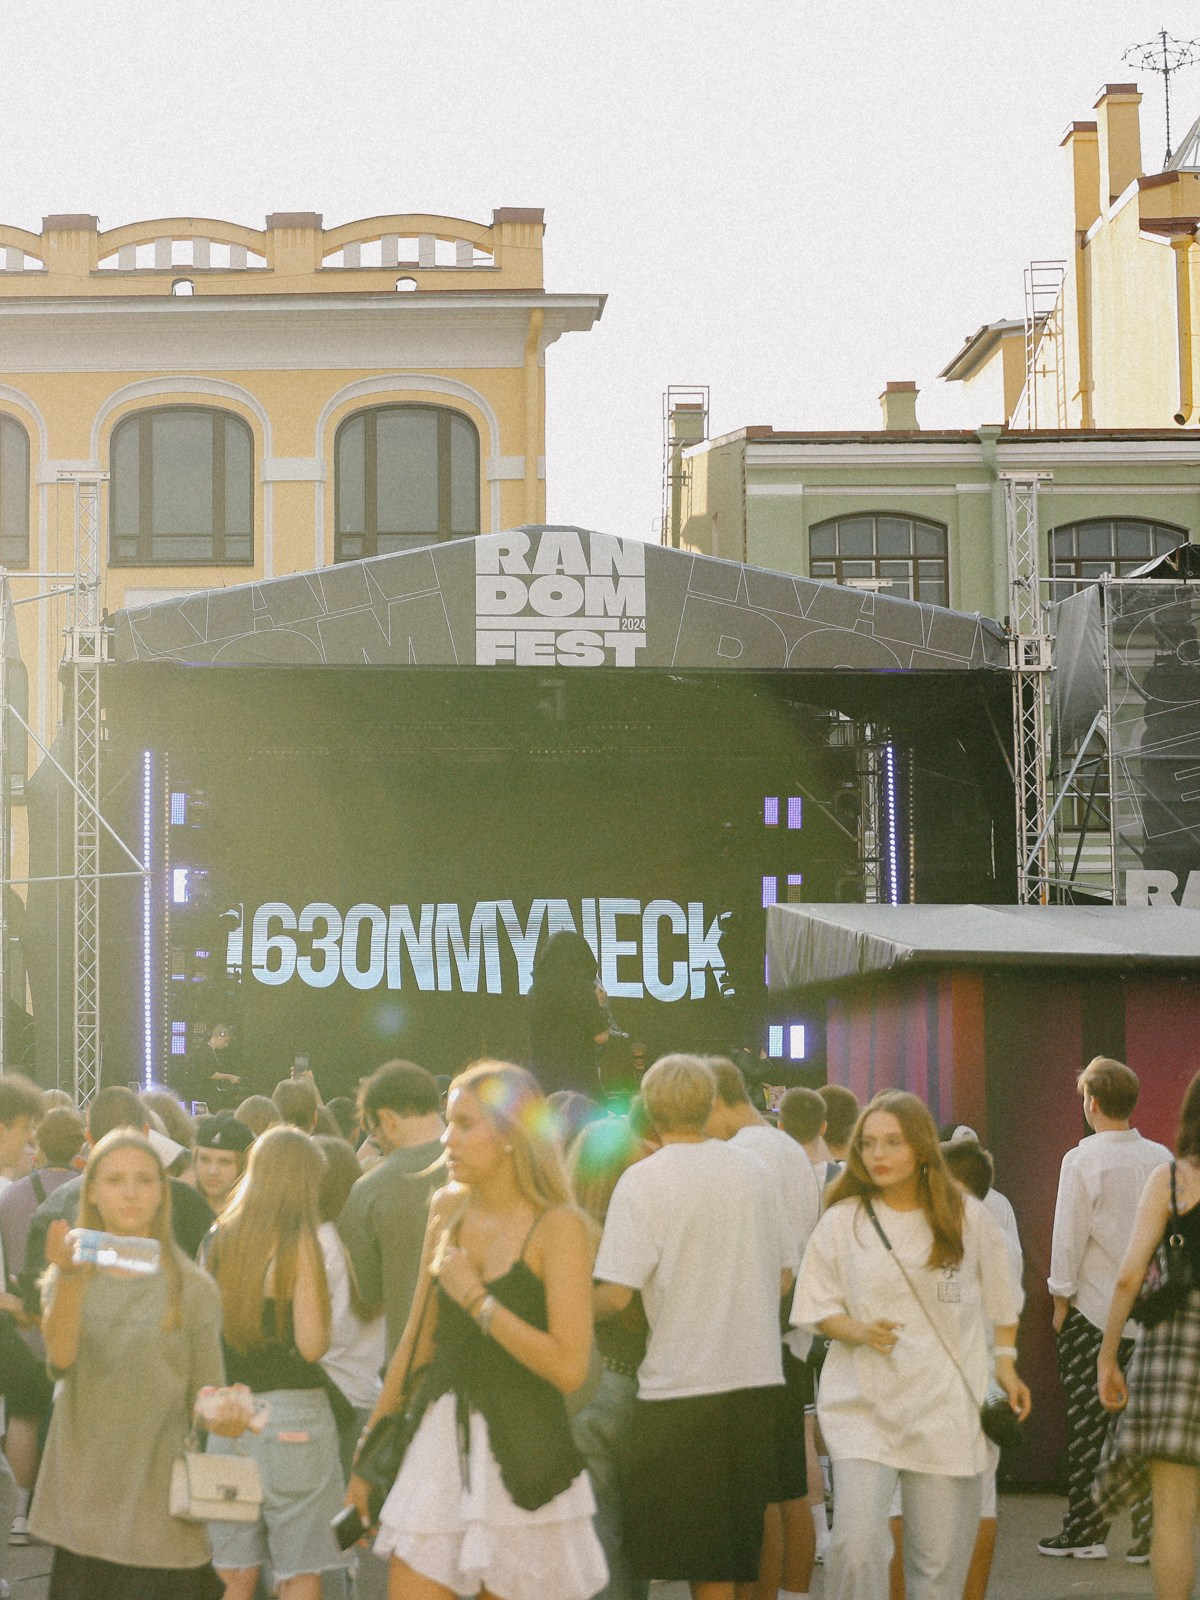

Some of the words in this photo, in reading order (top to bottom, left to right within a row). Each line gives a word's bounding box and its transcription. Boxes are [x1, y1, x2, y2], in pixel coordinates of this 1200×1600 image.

[475, 531, 646, 576] RAN
[475, 575, 646, 617] DOM
[621, 618, 647, 631] 2024
[475, 630, 647, 668] FEST
